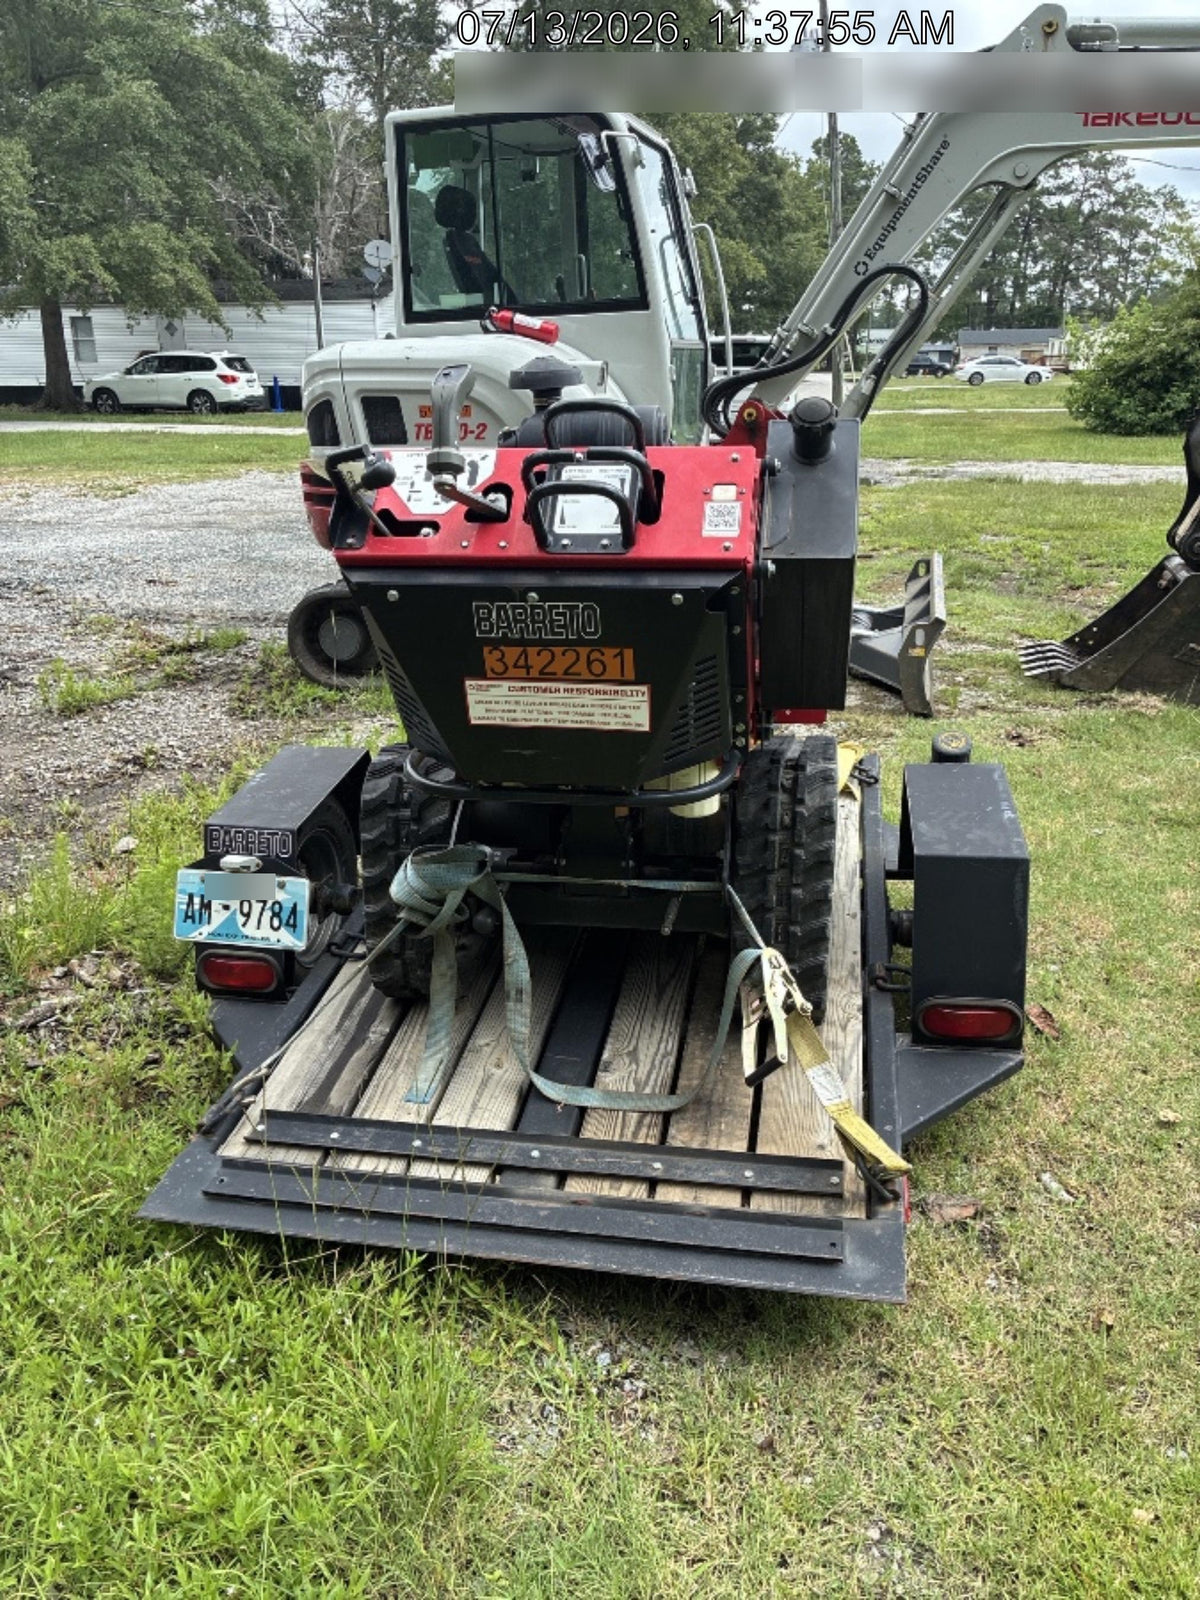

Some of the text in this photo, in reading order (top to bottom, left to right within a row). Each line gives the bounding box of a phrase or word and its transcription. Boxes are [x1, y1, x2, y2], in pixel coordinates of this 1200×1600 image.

[864, 139, 951, 261] EquipmentShare
[472, 602, 602, 639] BARRETO
[488, 647, 628, 678] 342261
[207, 826, 293, 858] BARRETO
